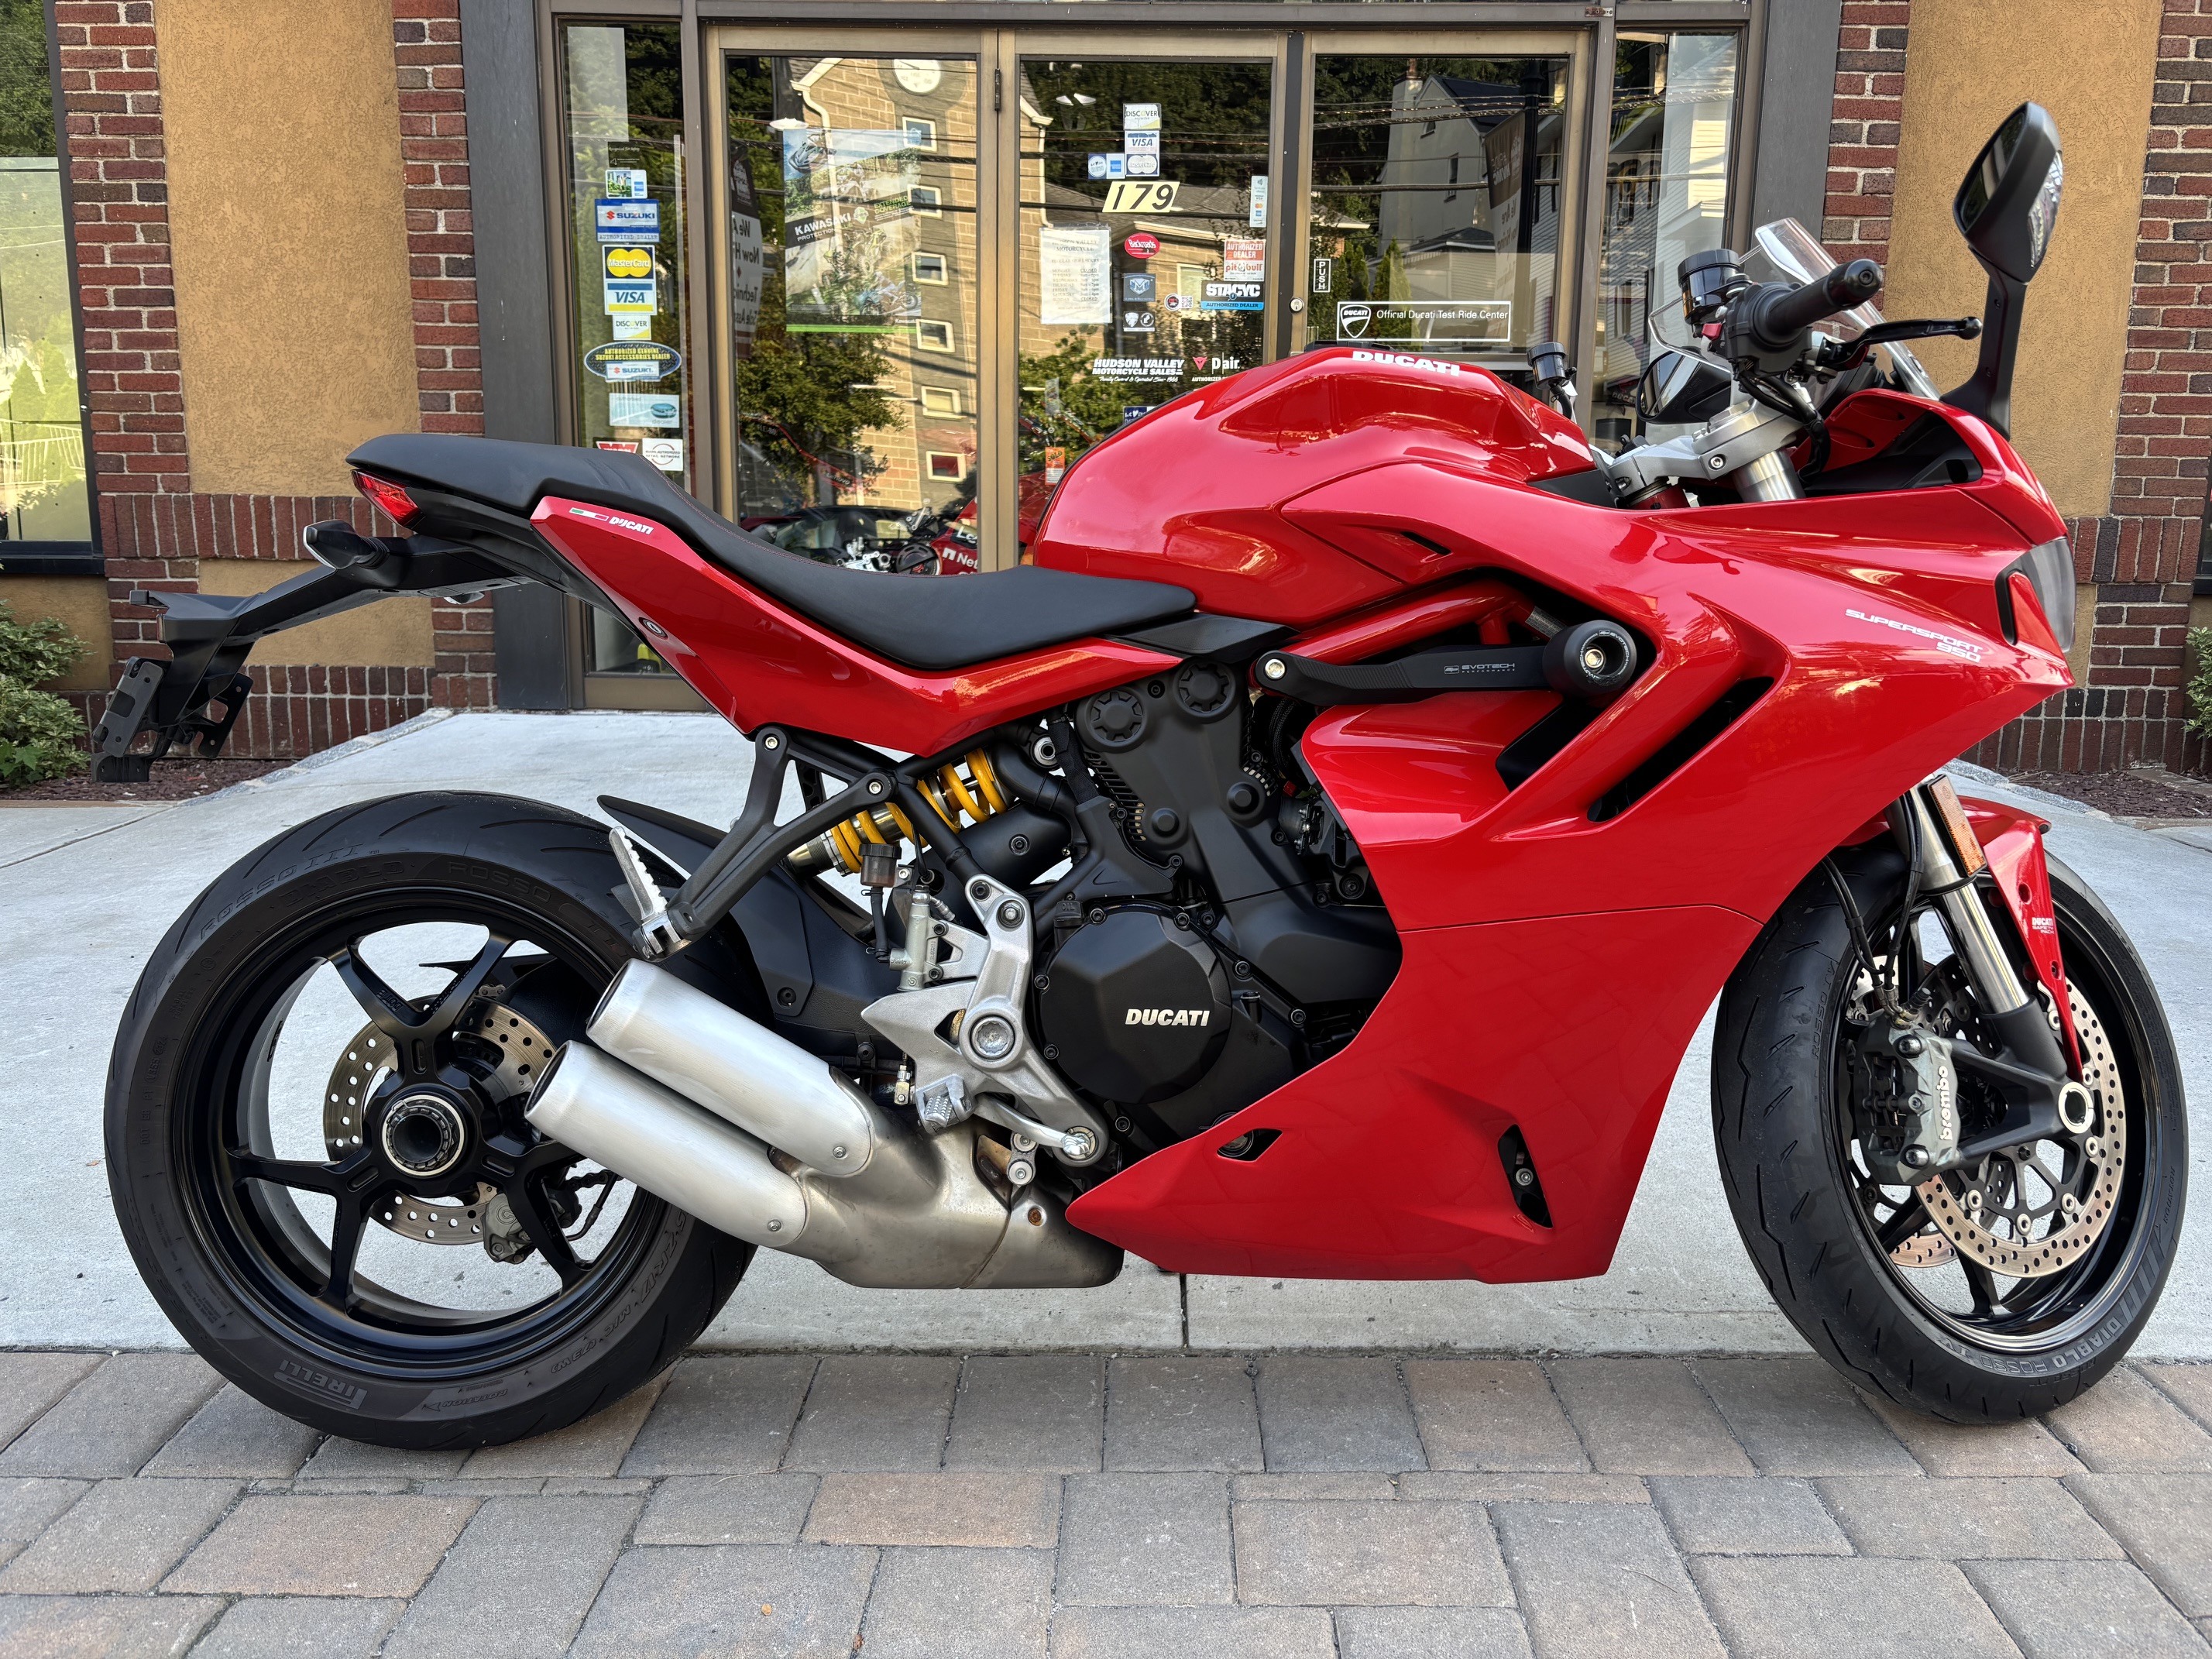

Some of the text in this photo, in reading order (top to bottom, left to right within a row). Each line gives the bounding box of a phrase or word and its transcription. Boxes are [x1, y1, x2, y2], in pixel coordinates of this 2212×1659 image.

[1132, 138, 1153, 147] VISA
[1111, 184, 1174, 211] 179
[794, 212, 852, 235] KAWASAKI
[607, 258, 651, 268] MasterCard
[1225, 263, 1263, 273] pit bull
[615, 291, 646, 303] VISA
[1206, 283, 1261, 297] STACYC
[1376, 311, 1508, 319] Official Ducati Test Ride Center
[1094, 359, 1185, 368] HUDSON VALLEY
[1352, 350, 1461, 377] DUCATI
[1047, 450, 1063, 462] SOLD
[609, 516, 654, 535] DUCATI
[1844, 608, 1984, 654] SUPERSPORT
[1936, 641, 1981, 663] 950
[447, 860, 551, 904] ROSSO
[2032, 917, 2053, 926] DUCATI
[1125, 1008, 1211, 1027] DUCATI
[1936, 1065, 1953, 1141] brembo
[2052, 1317, 2123, 1369] DIABLO
[1980, 1355, 2047, 1373] ROSSO
[273, 1359, 369, 1410] PIRELLI
[441, 1389, 507, 1408] ROTATION
